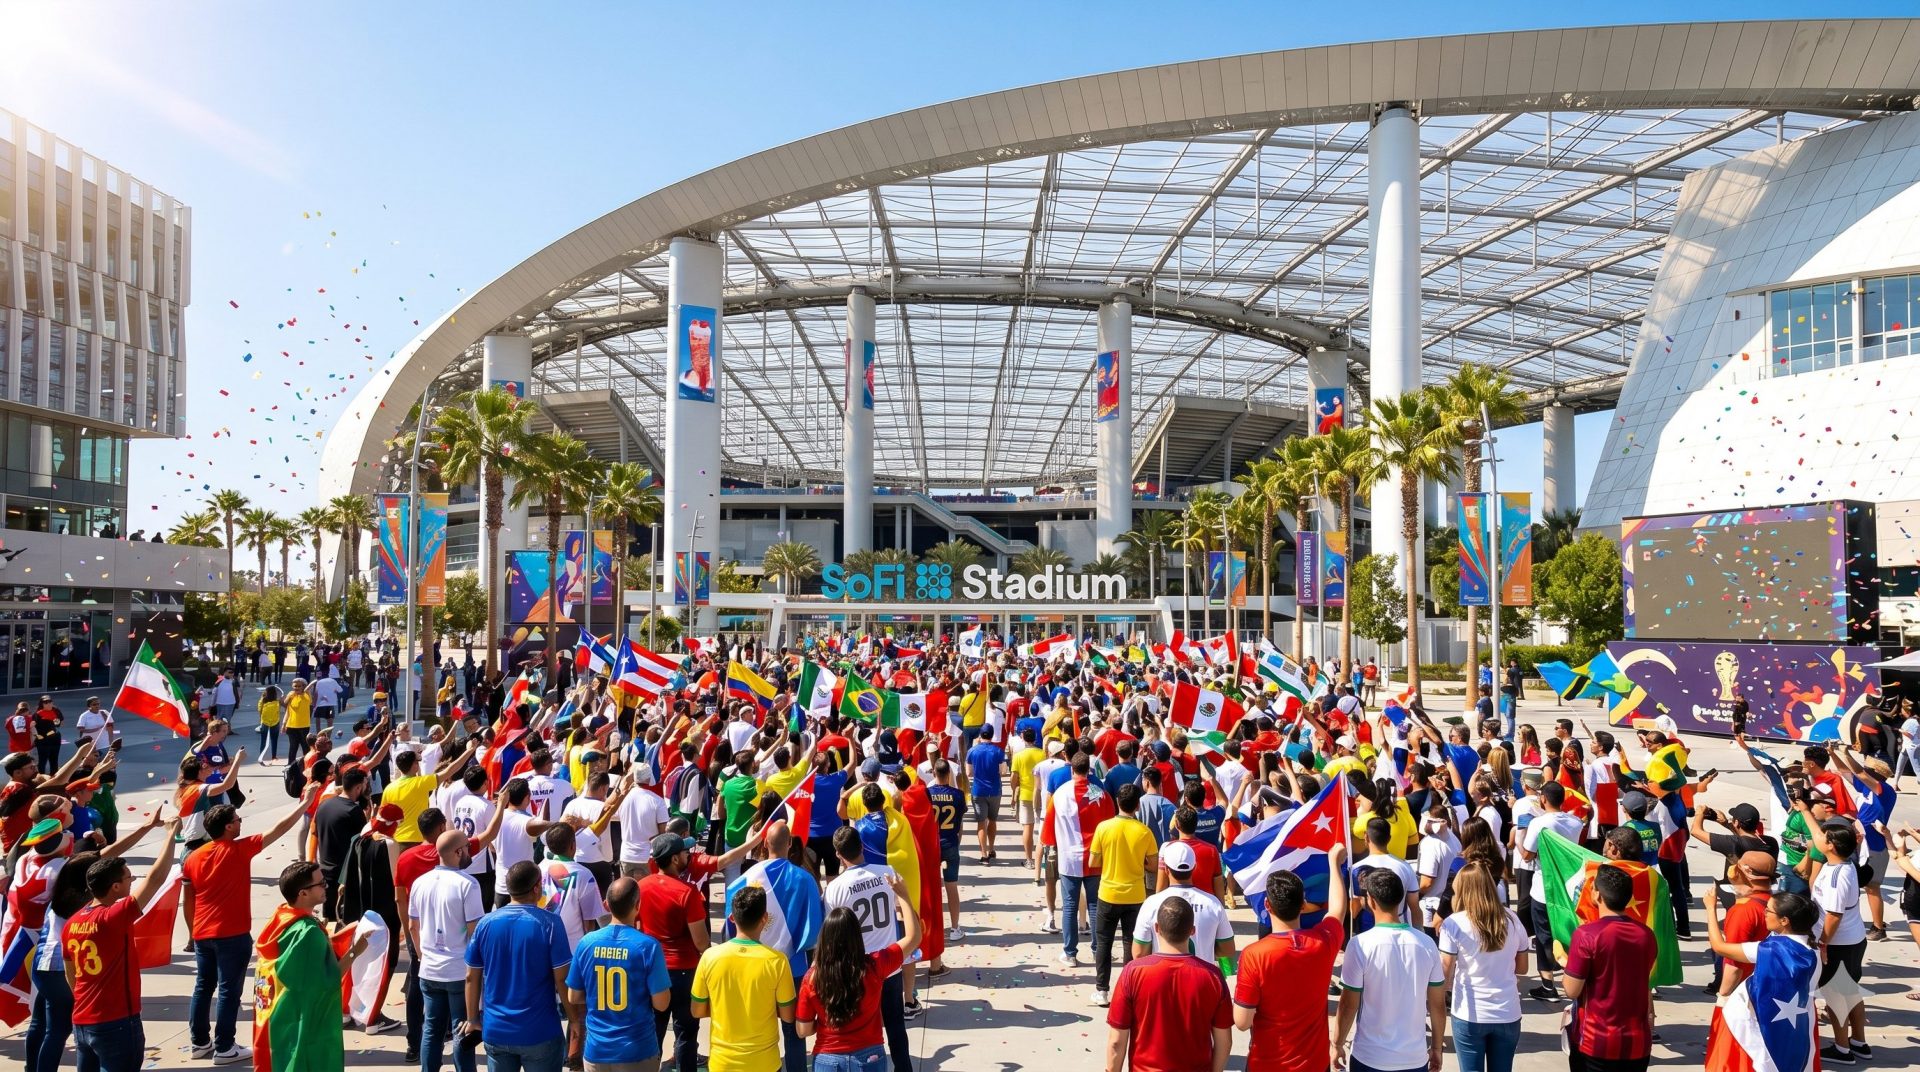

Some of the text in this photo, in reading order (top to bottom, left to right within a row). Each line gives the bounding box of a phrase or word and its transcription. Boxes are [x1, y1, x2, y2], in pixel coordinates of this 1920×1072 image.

[821, 563, 1127, 600] SoFi Stadium
[853, 892, 890, 933] 20
[595, 965, 628, 1011] 10
